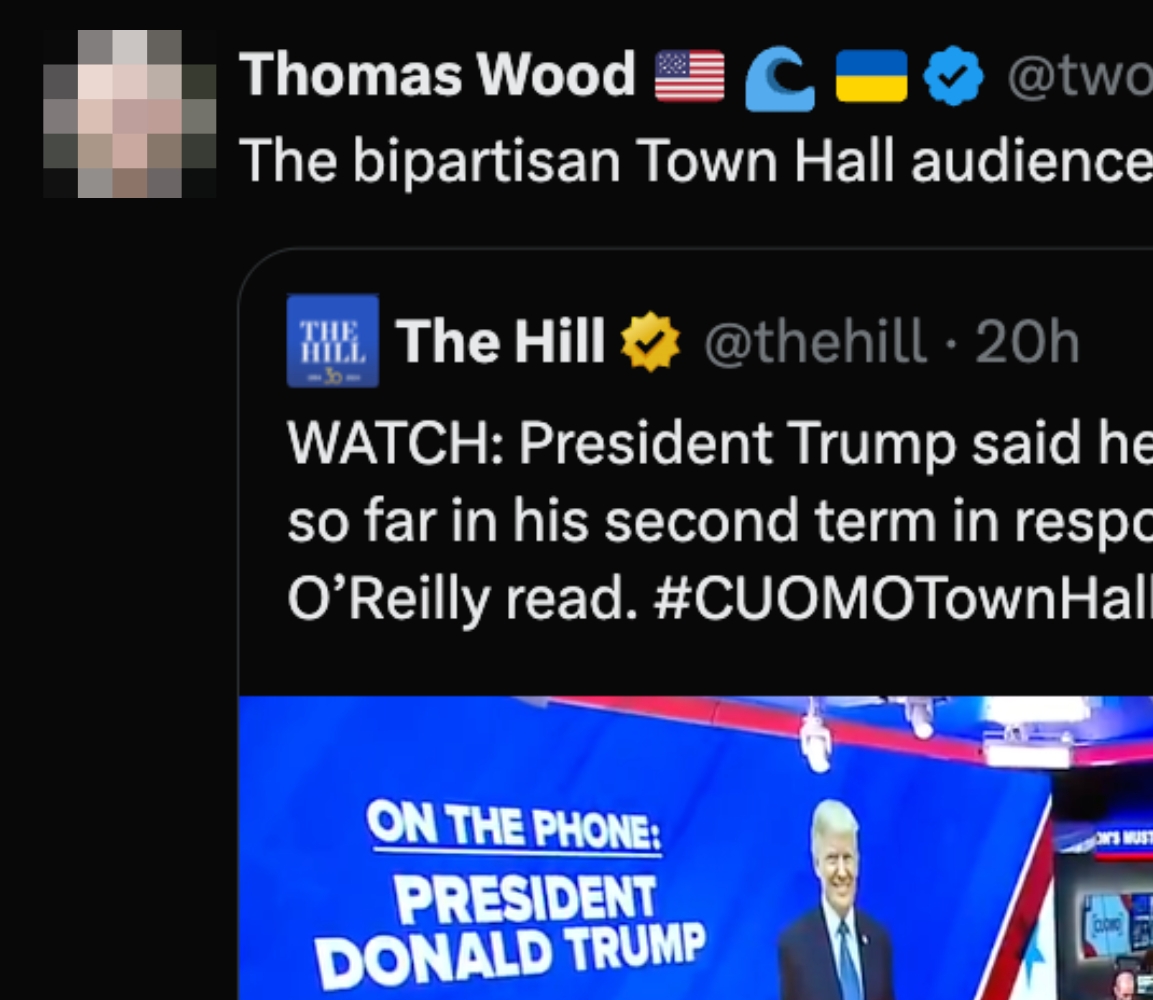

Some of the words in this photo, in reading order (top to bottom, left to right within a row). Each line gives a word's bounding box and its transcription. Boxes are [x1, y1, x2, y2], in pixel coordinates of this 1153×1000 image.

[239, 49, 462, 97] Thomas
[476, 49, 634, 97] Wood
[239, 135, 337, 183] The
[355, 135, 619, 194] bipartisan
[635, 138, 776, 183] Town
[797, 135, 893, 183] Hall
[299, 320, 358, 341] THE
[302, 342, 367, 363] HILL
[395, 316, 500, 364] The
[516, 316, 604, 363] Hill
[706, 317, 927, 368] @thehill
[977, 317, 1078, 363] 20h
[286, 420, 503, 466] WATCH:
[521, 418, 774, 465] President
[786, 420, 957, 476] Trump
[972, 418, 1080, 465] said
[288, 508, 349, 543] so
[364, 495, 438, 543] far
[452, 496, 496, 542] in
[515, 495, 589, 543] his
[605, 495, 798, 543] second
[814, 500, 936, 543] term
[954, 496, 998, 542] in
[288, 573, 492, 632] O’Reilly
[508, 573, 637, 621] read.
[367, 799, 437, 843] ON
[445, 805, 524, 848] THE
[532, 810, 662, 851] PHONE:
[394, 874, 656, 926] PRESIDENT
[315, 929, 552, 991] DONALD
[564, 921, 707, 971] TRUMP
